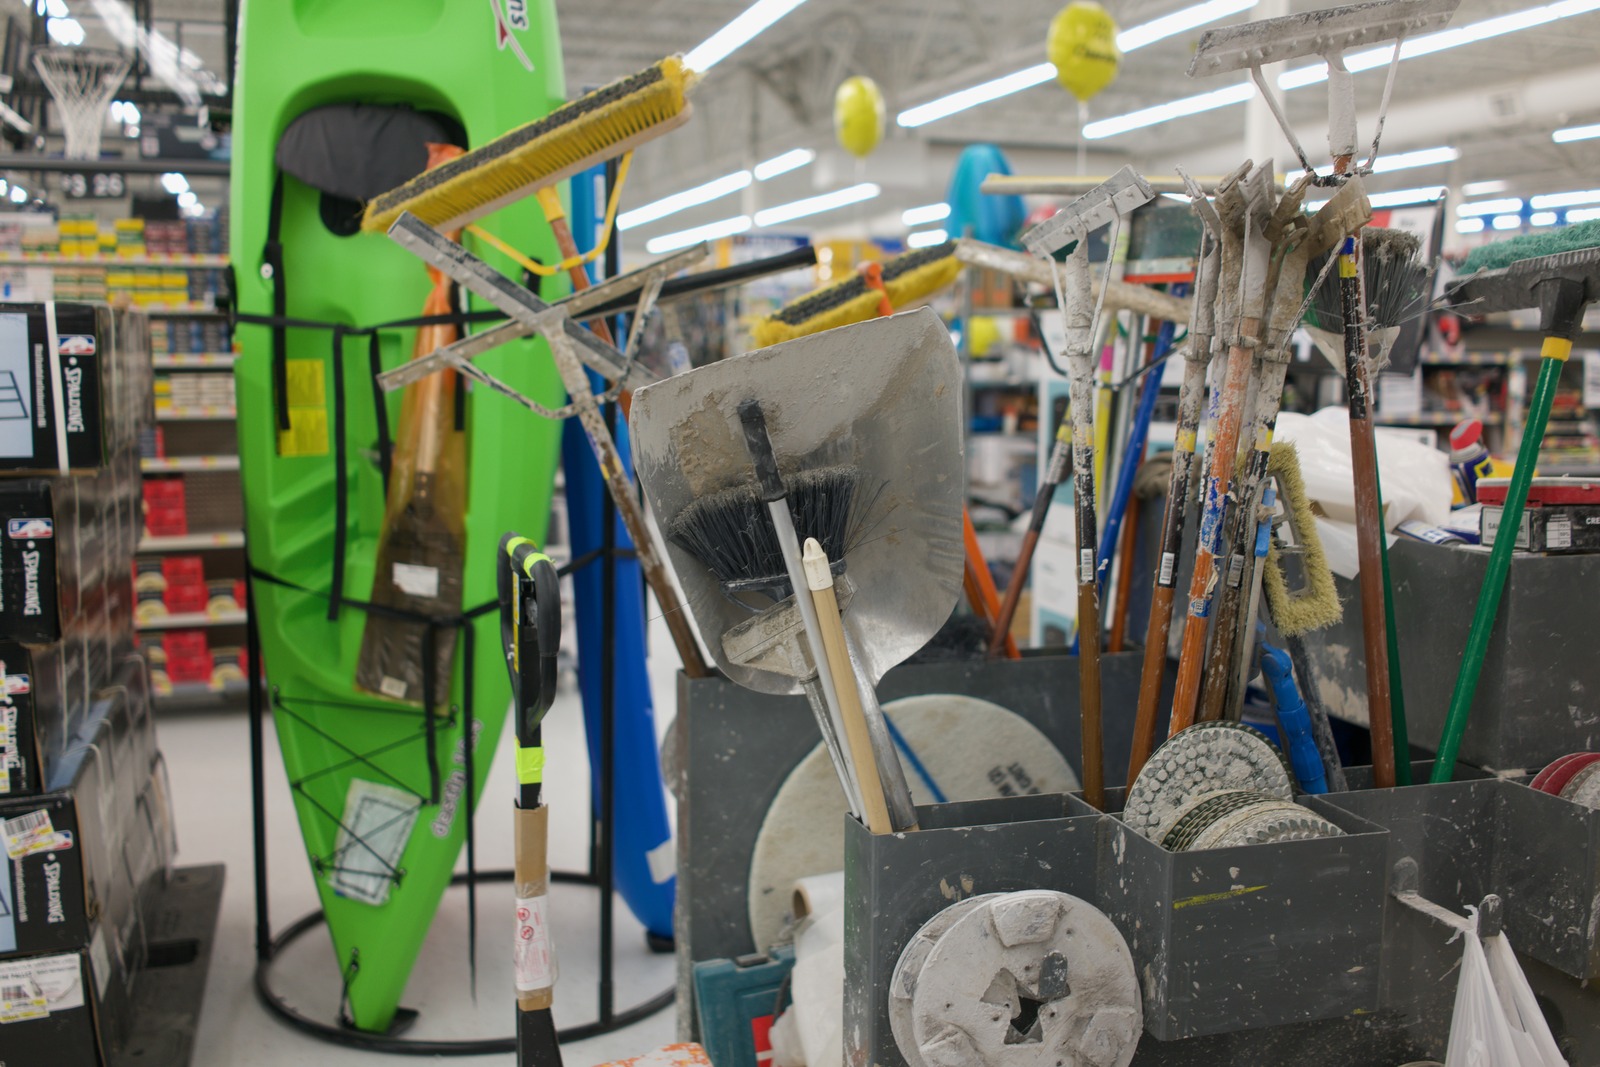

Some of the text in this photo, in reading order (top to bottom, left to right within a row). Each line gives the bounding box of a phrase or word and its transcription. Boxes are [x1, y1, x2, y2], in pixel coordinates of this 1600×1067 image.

[64, 367, 85, 433] SPALDING
[22, 550, 42, 615] SPALDING
[43, 861, 65, 923] SPALDING
